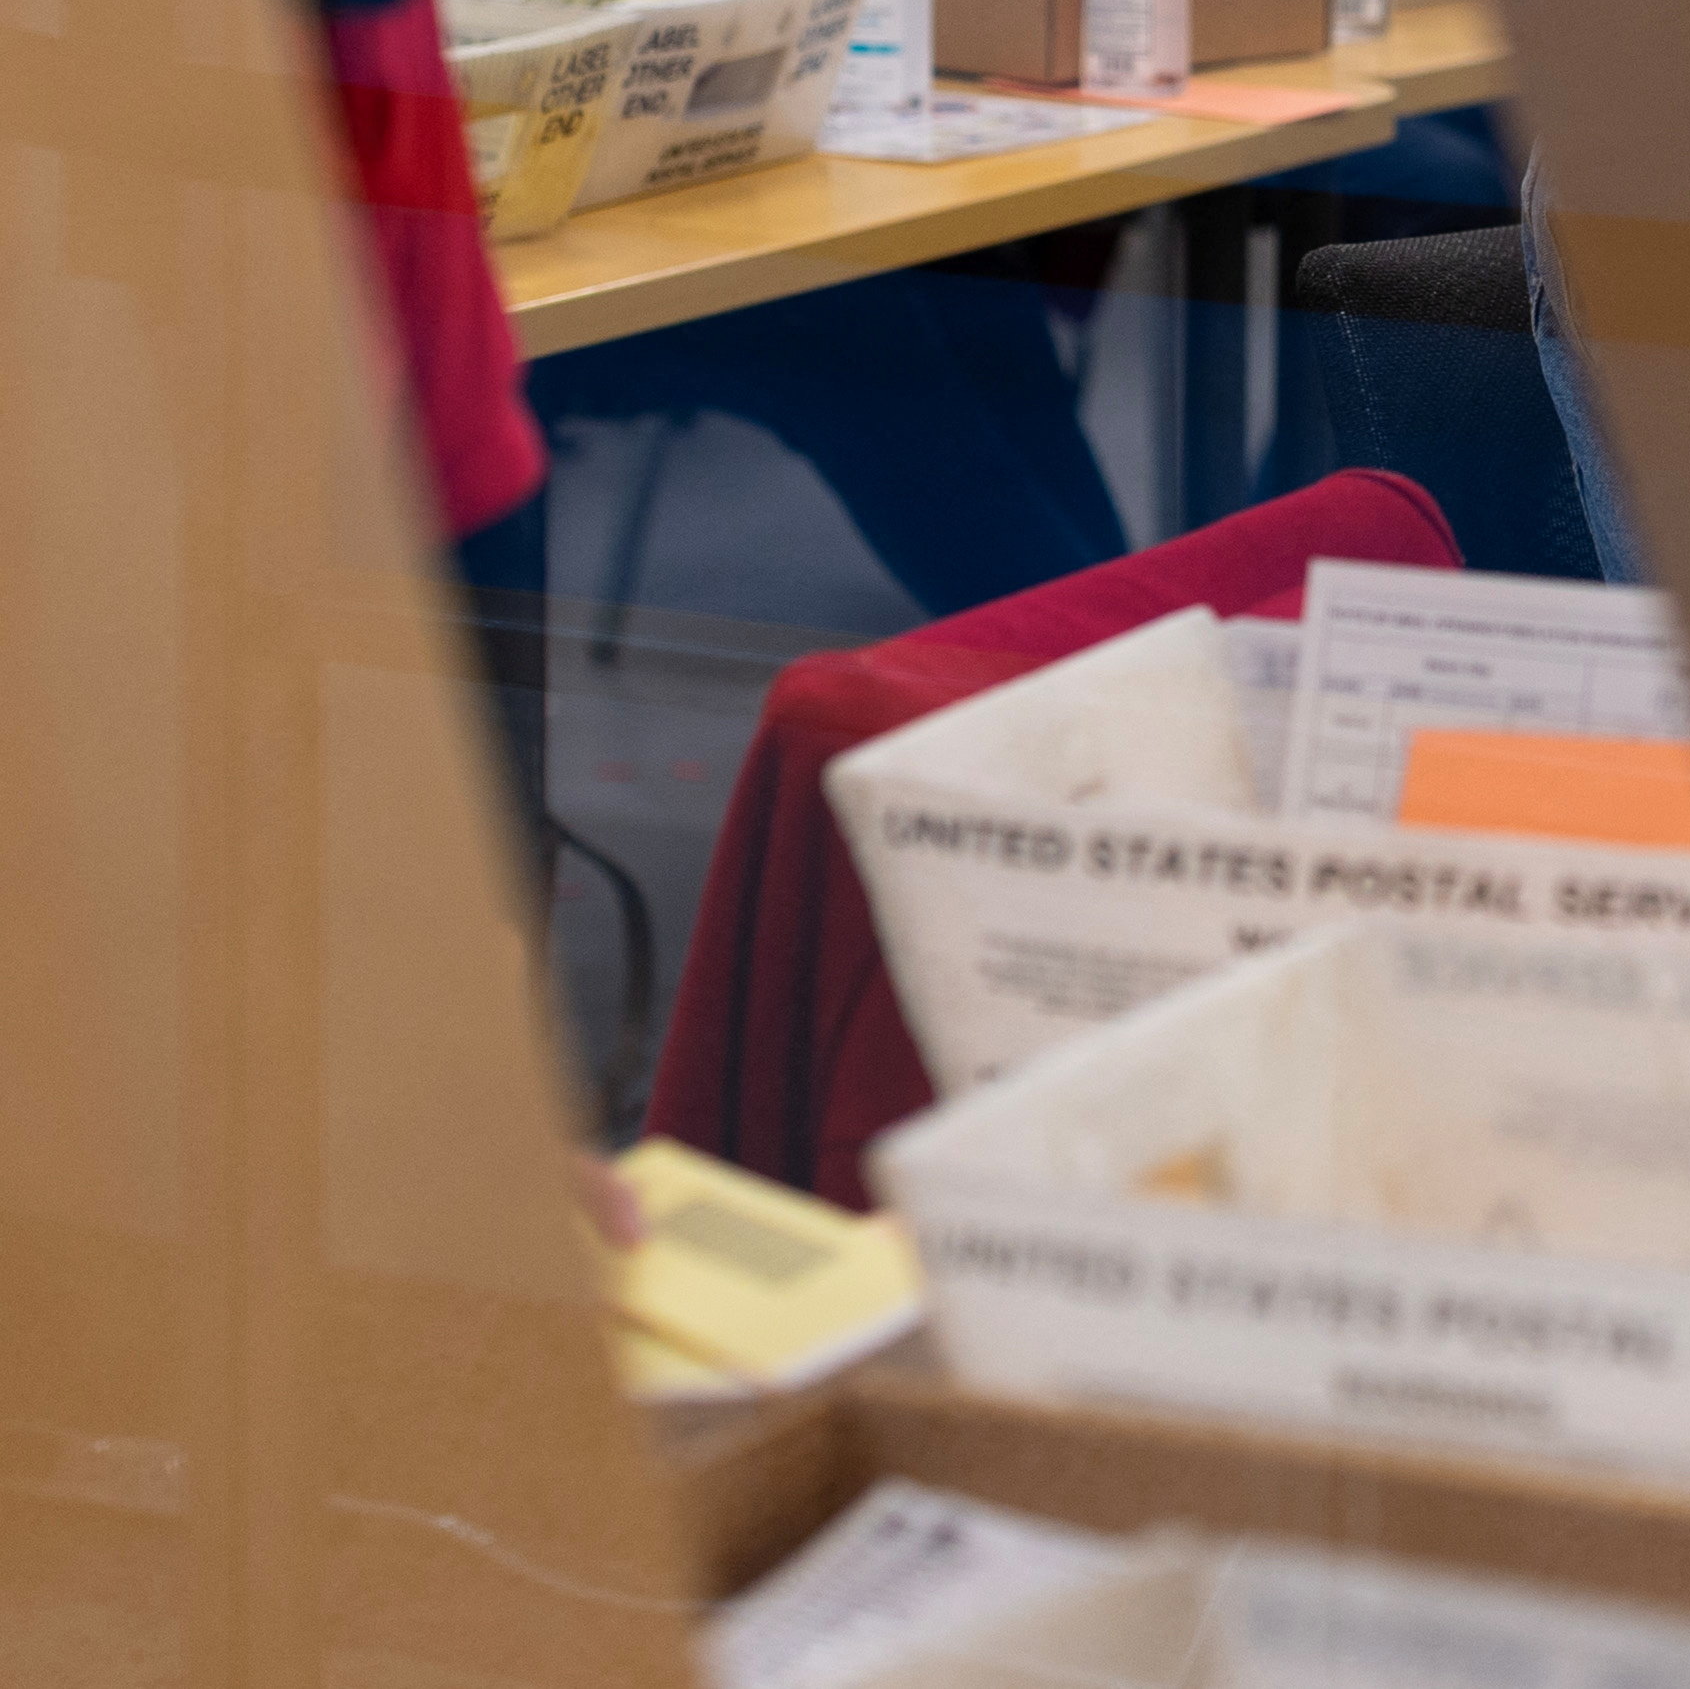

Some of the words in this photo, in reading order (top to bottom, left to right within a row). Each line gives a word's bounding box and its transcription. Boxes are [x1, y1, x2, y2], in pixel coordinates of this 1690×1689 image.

[880, 805, 1074, 874] UNITED
[1082, 826, 1289, 897] STATES
[1308, 851, 1530, 917] POSTAL
